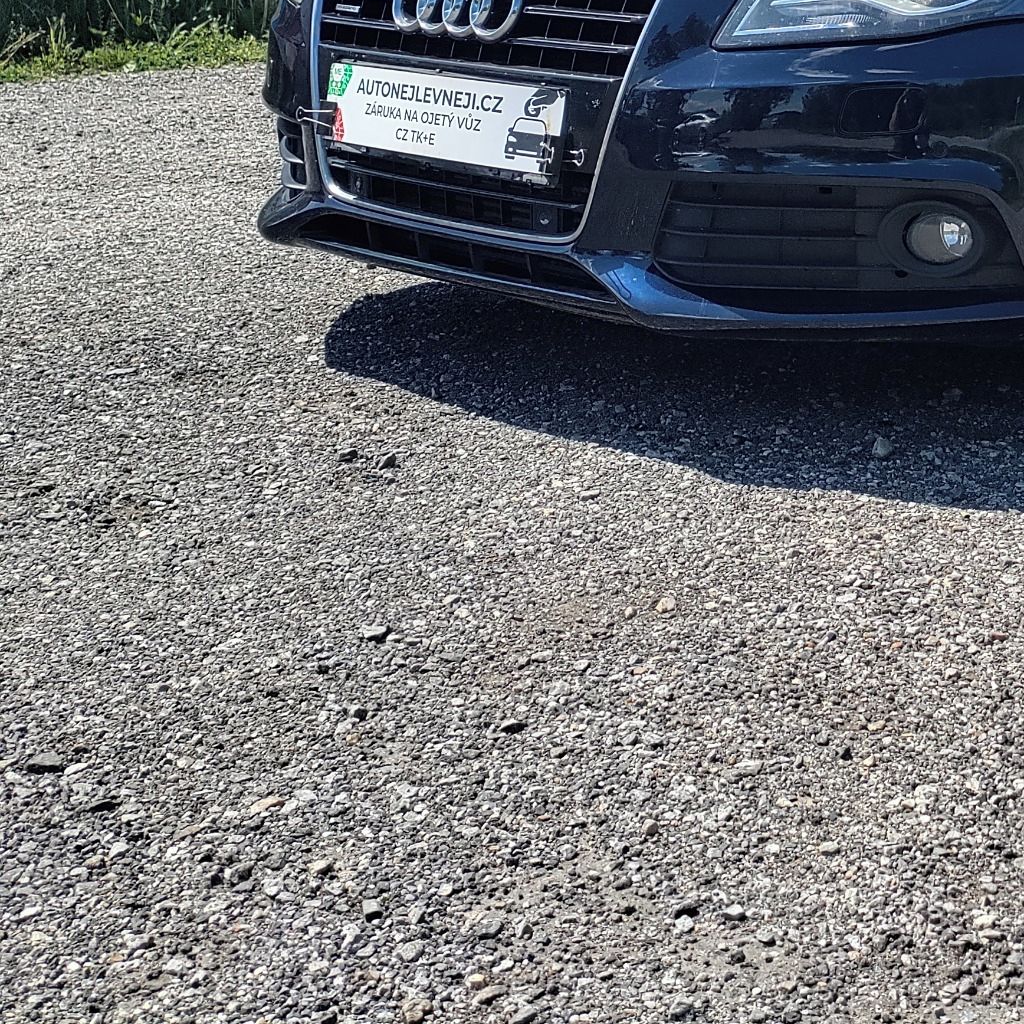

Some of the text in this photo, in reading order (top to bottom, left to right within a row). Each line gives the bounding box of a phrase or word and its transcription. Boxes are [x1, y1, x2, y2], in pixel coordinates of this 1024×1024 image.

[357, 78, 504, 113] AUTONEJLEVNEJI.CZ
[365, 101, 482, 132] ZÁRUKA NA OJETÝ VŮZ
[395, 128, 436, 146] CZ TK+E
